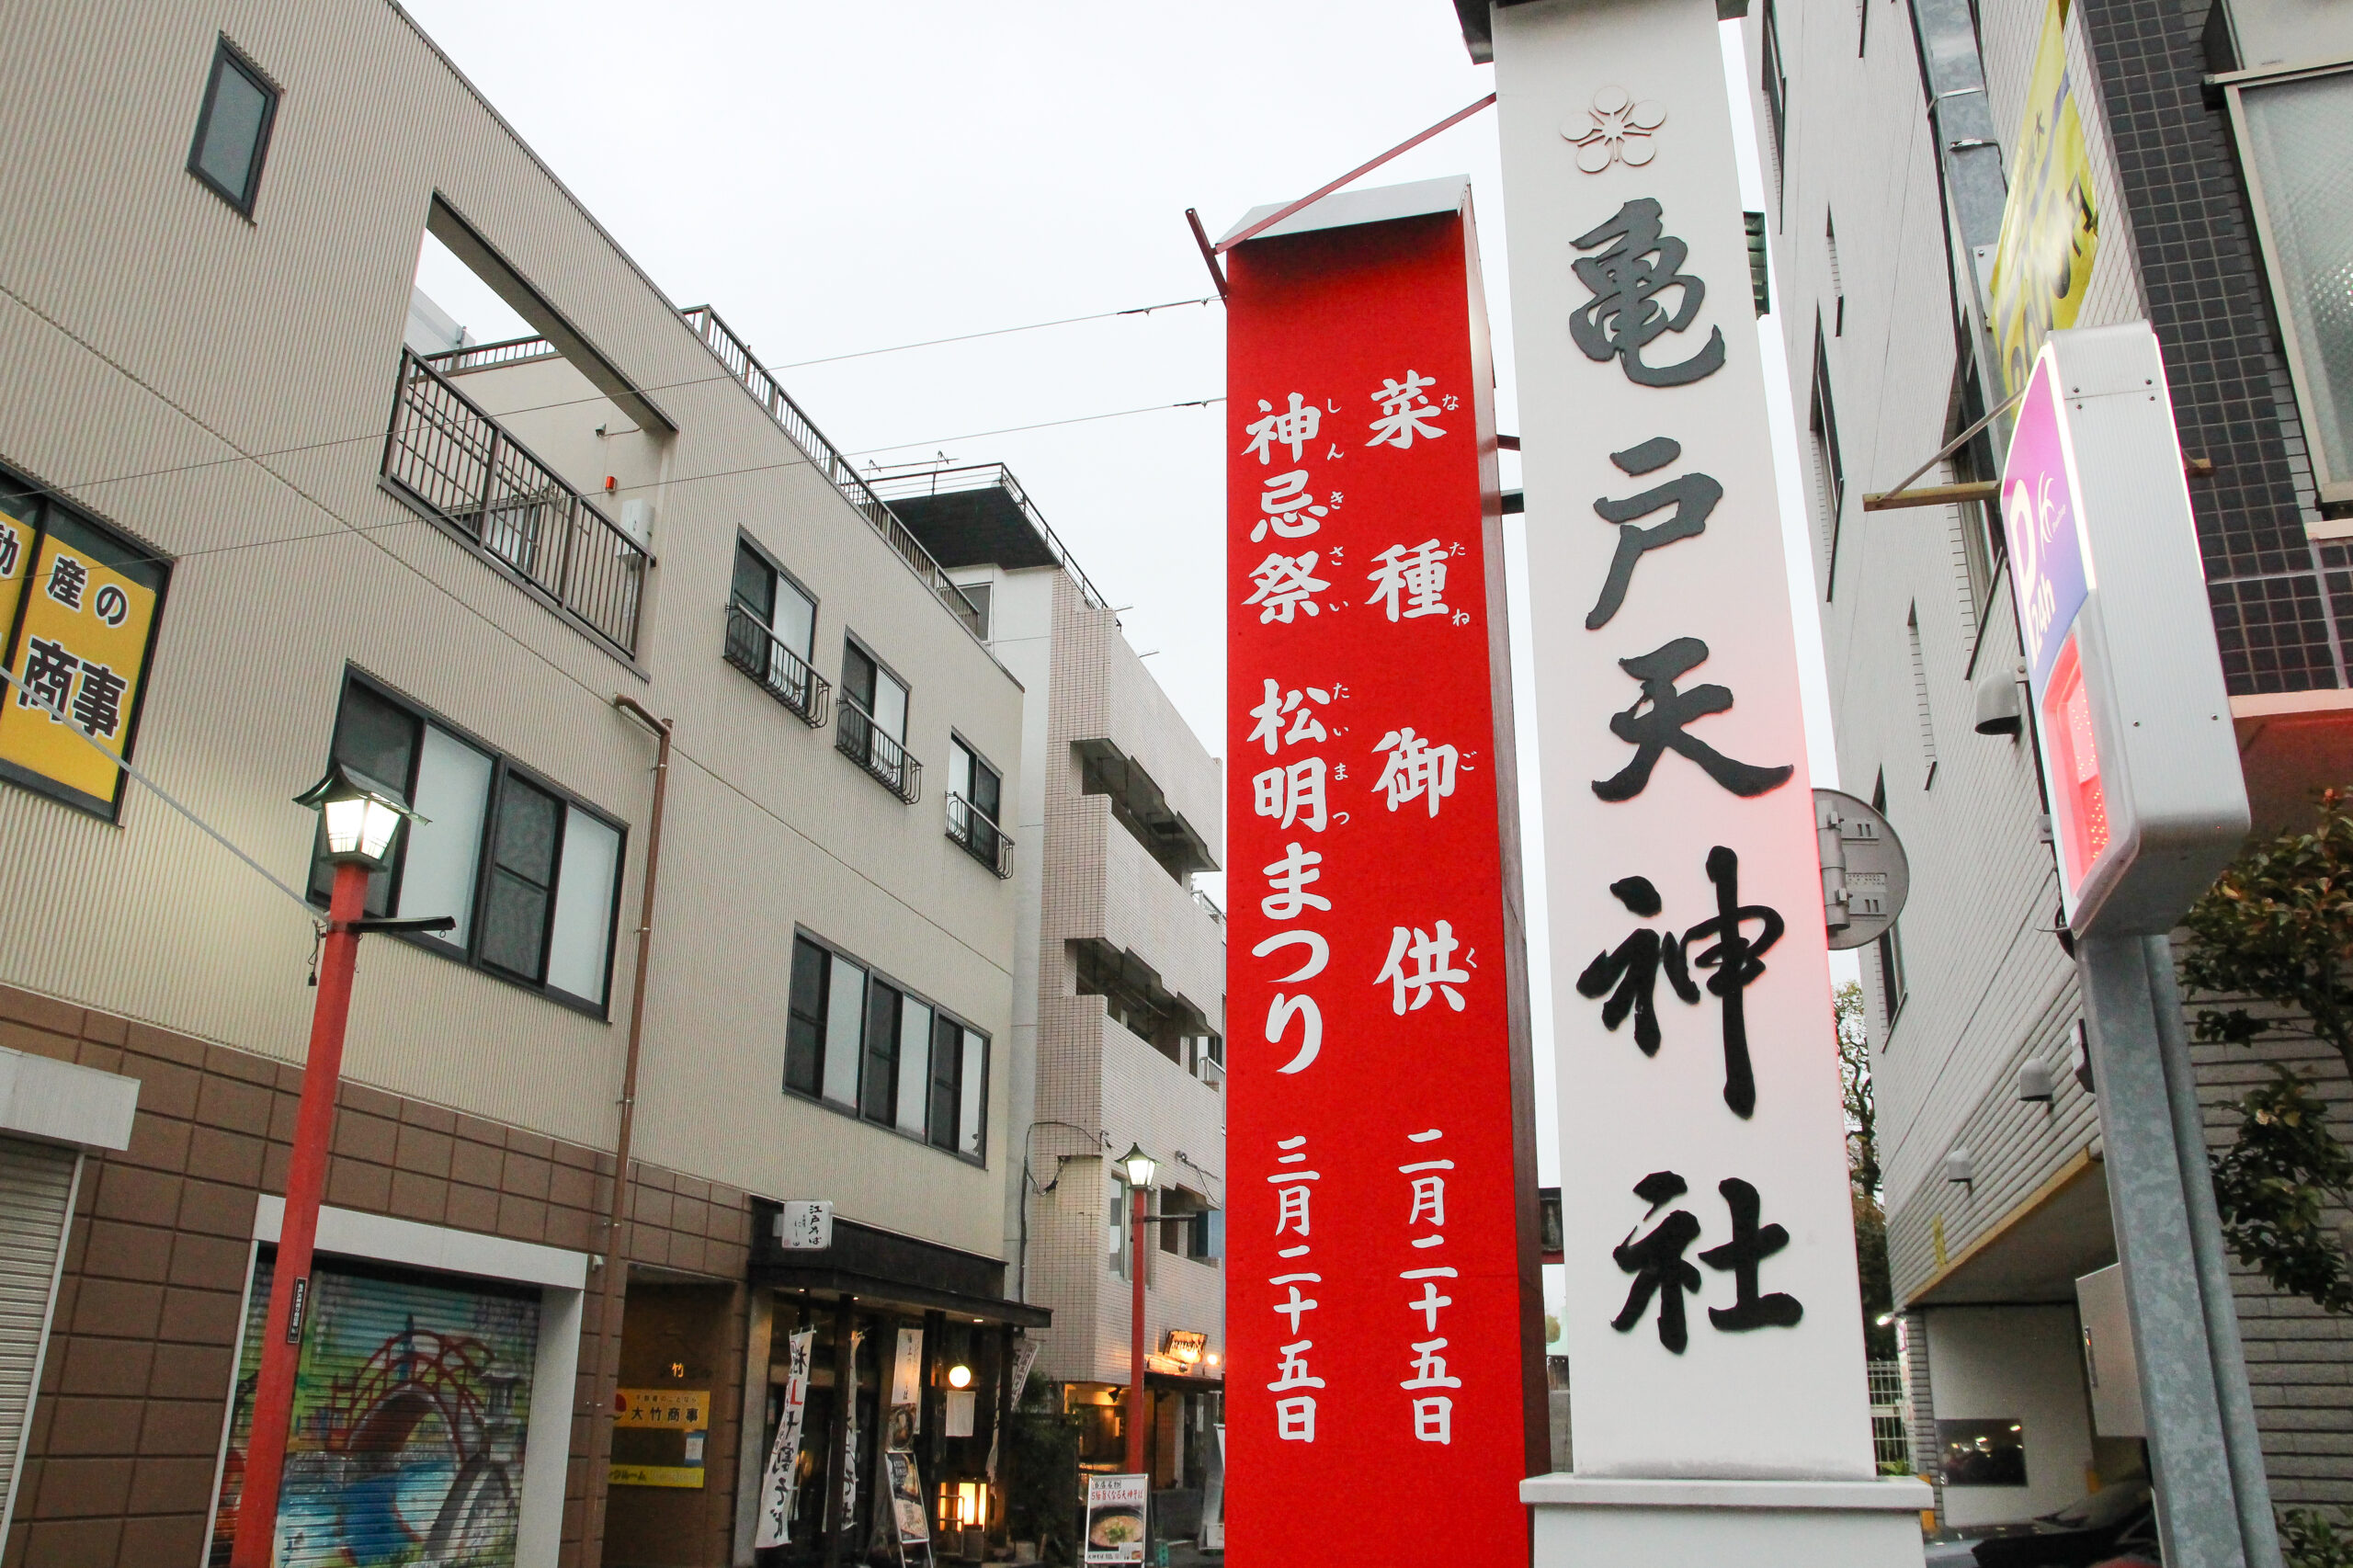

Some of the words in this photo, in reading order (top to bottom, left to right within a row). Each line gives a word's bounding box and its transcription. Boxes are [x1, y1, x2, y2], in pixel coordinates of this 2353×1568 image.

[2009, 478, 2038, 670] P
[2030, 572, 2056, 655] 24h
[17, 637, 126, 738] 商事
[1569, 198, 1804, 1354] 亀戸天神社
[1267, 1135, 1325, 1442] 三月二十五日
[1399, 1129, 1461, 1444] 二月二十五日
[631, 1406, 699, 1423] 大竹商事
